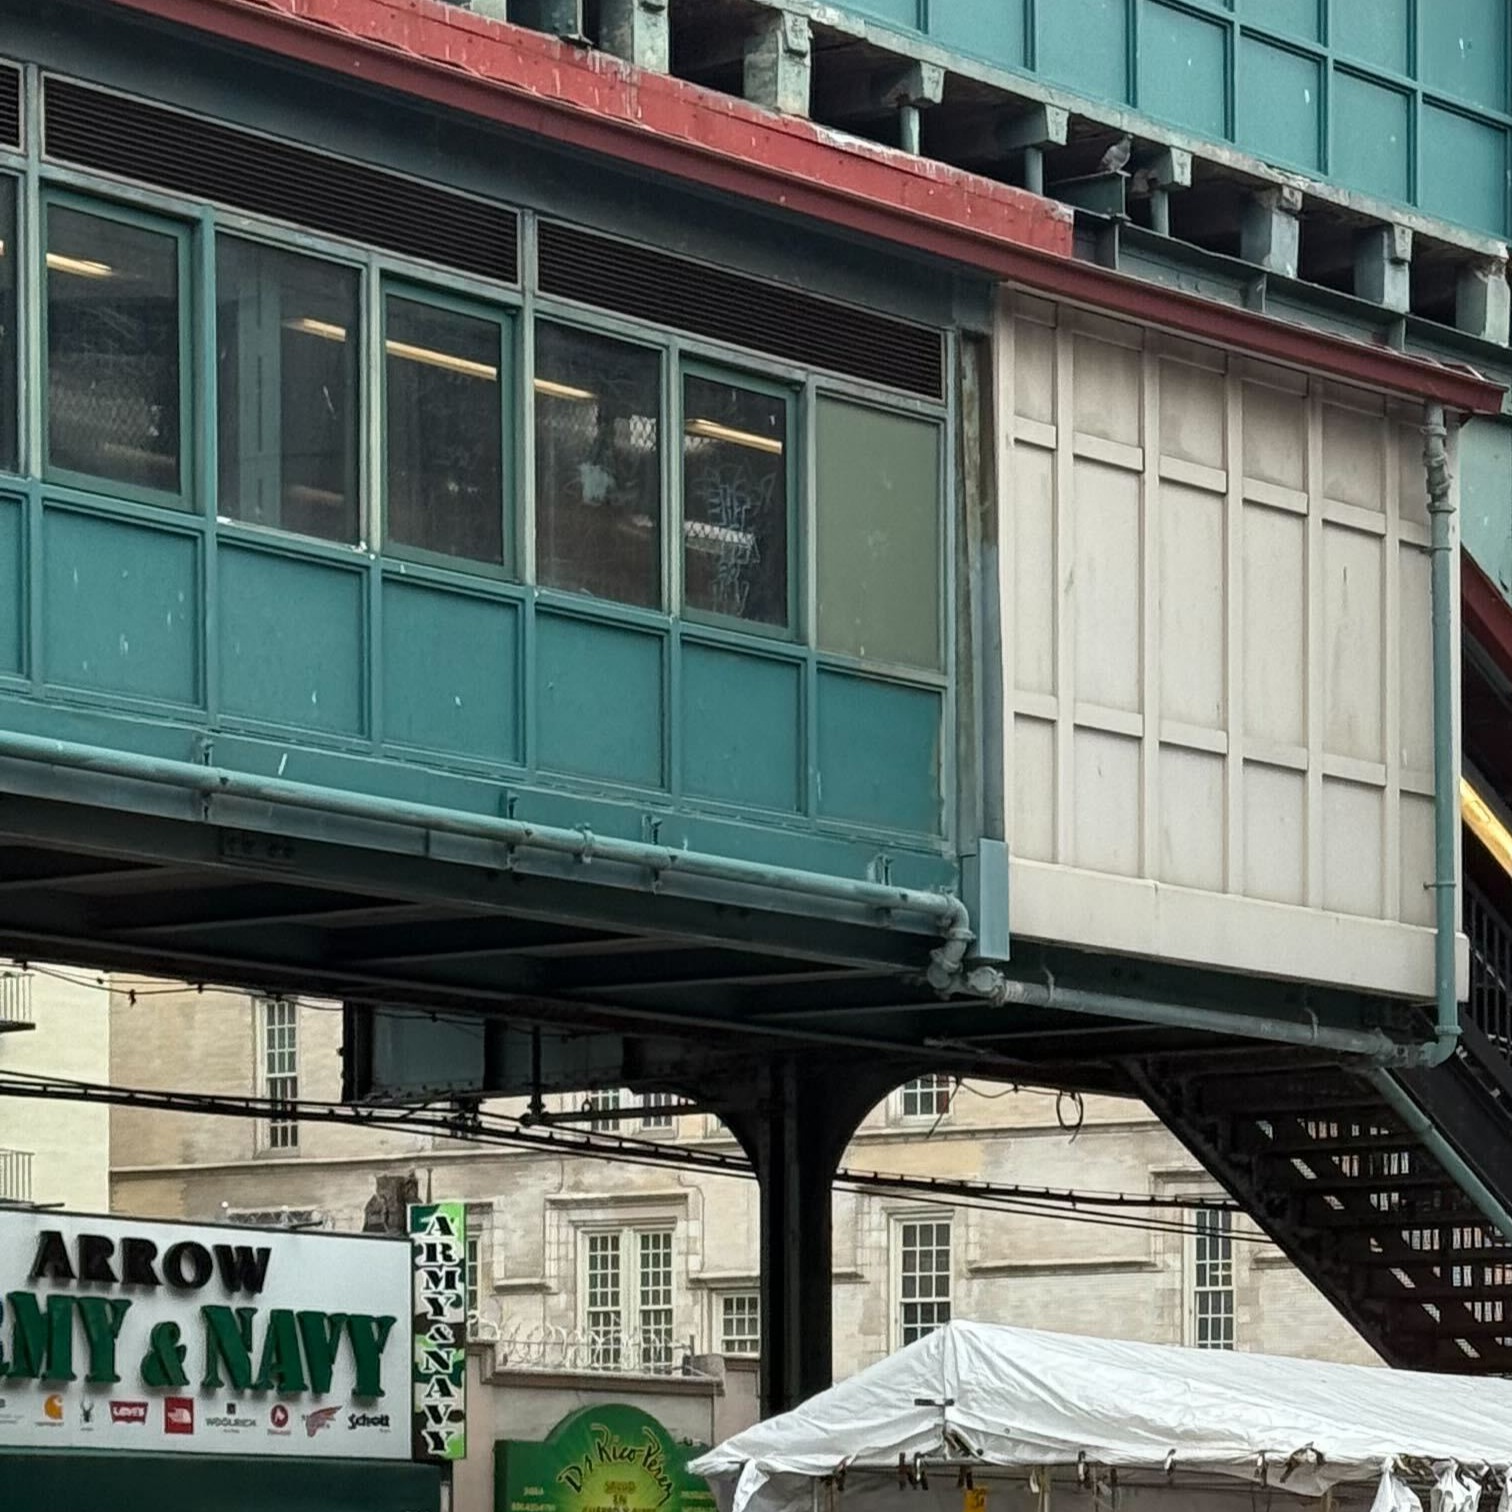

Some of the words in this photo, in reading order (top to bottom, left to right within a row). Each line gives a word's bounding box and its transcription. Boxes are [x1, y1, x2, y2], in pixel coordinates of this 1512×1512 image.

[27, 1230, 272, 1294] ARROW
[0, 1291, 133, 1383] MY
[140, 1320, 191, 1387] &
[201, 1304, 398, 1398] NAVY
[348, 1413, 391, 1430] Schott
